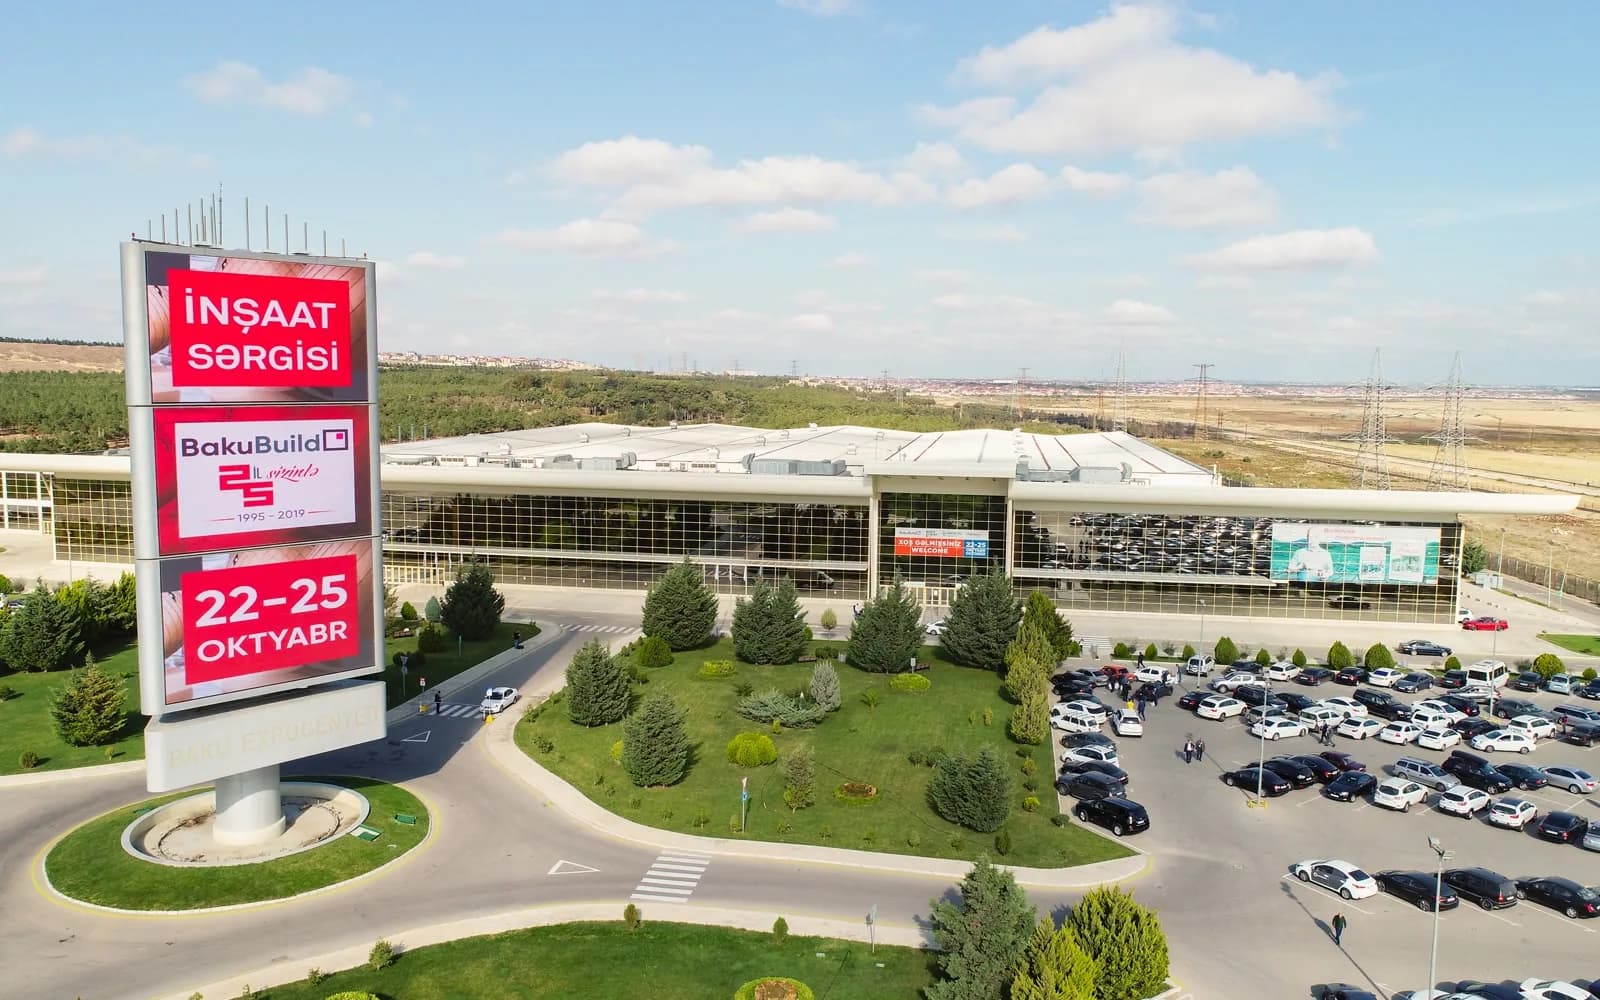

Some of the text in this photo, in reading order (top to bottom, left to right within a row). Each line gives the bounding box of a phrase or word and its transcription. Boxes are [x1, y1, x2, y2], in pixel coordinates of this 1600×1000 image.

[185, 288, 336, 334] İNŞAAT
[188, 340, 338, 371] SƏRGİSİ
[181, 434, 320, 457] BakuBuild
[219, 464, 274, 508] 25
[239, 514, 265, 523] 1995
[278, 509, 305, 520] 2019
[195, 574, 348, 628] 22-25
[197, 620, 348, 662] OKTYABR
